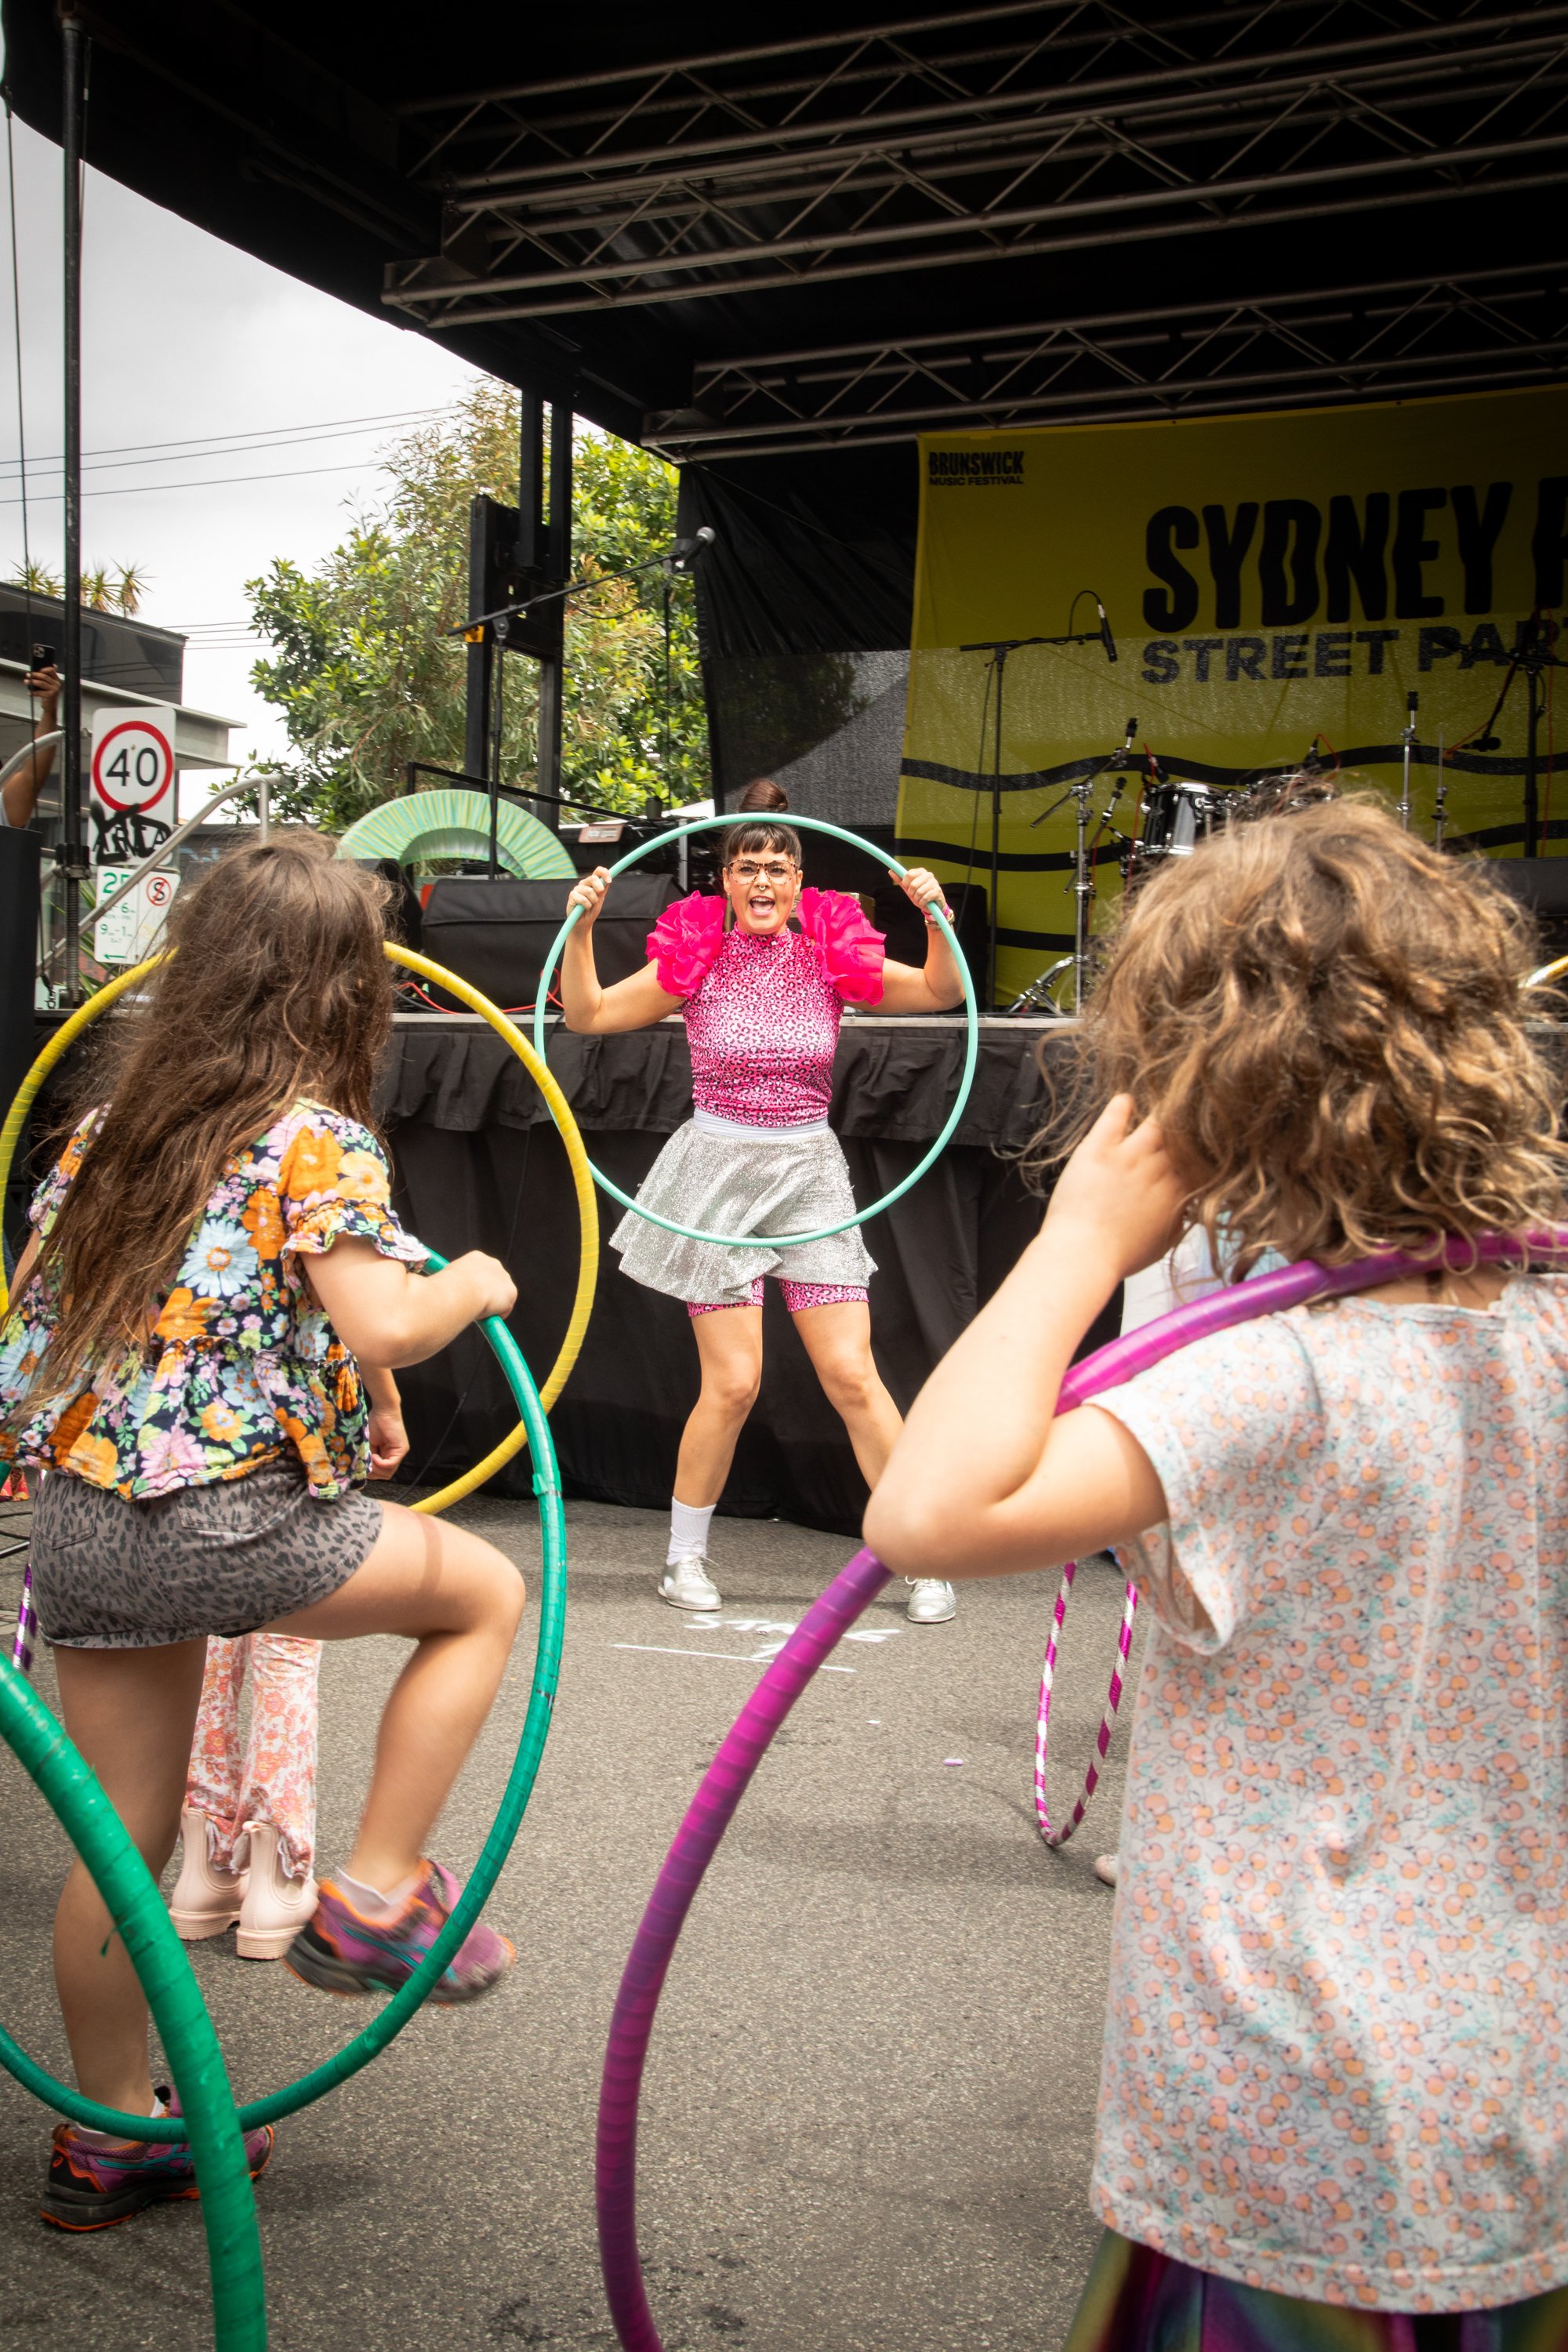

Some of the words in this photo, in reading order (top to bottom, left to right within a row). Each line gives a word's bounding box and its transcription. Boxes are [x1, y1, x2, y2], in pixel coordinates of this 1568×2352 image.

[928, 451, 1024, 476] BRUNSWICK
[928, 476, 966, 486] MUSIC
[968, 474, 1024, 485] FESTIVAL
[1142, 481, 1513, 633] SYDNEY
[1142, 629, 1399, 684] STREET
[1417, 617, 1568, 672] PAR
[105, 747, 158, 787] 40
